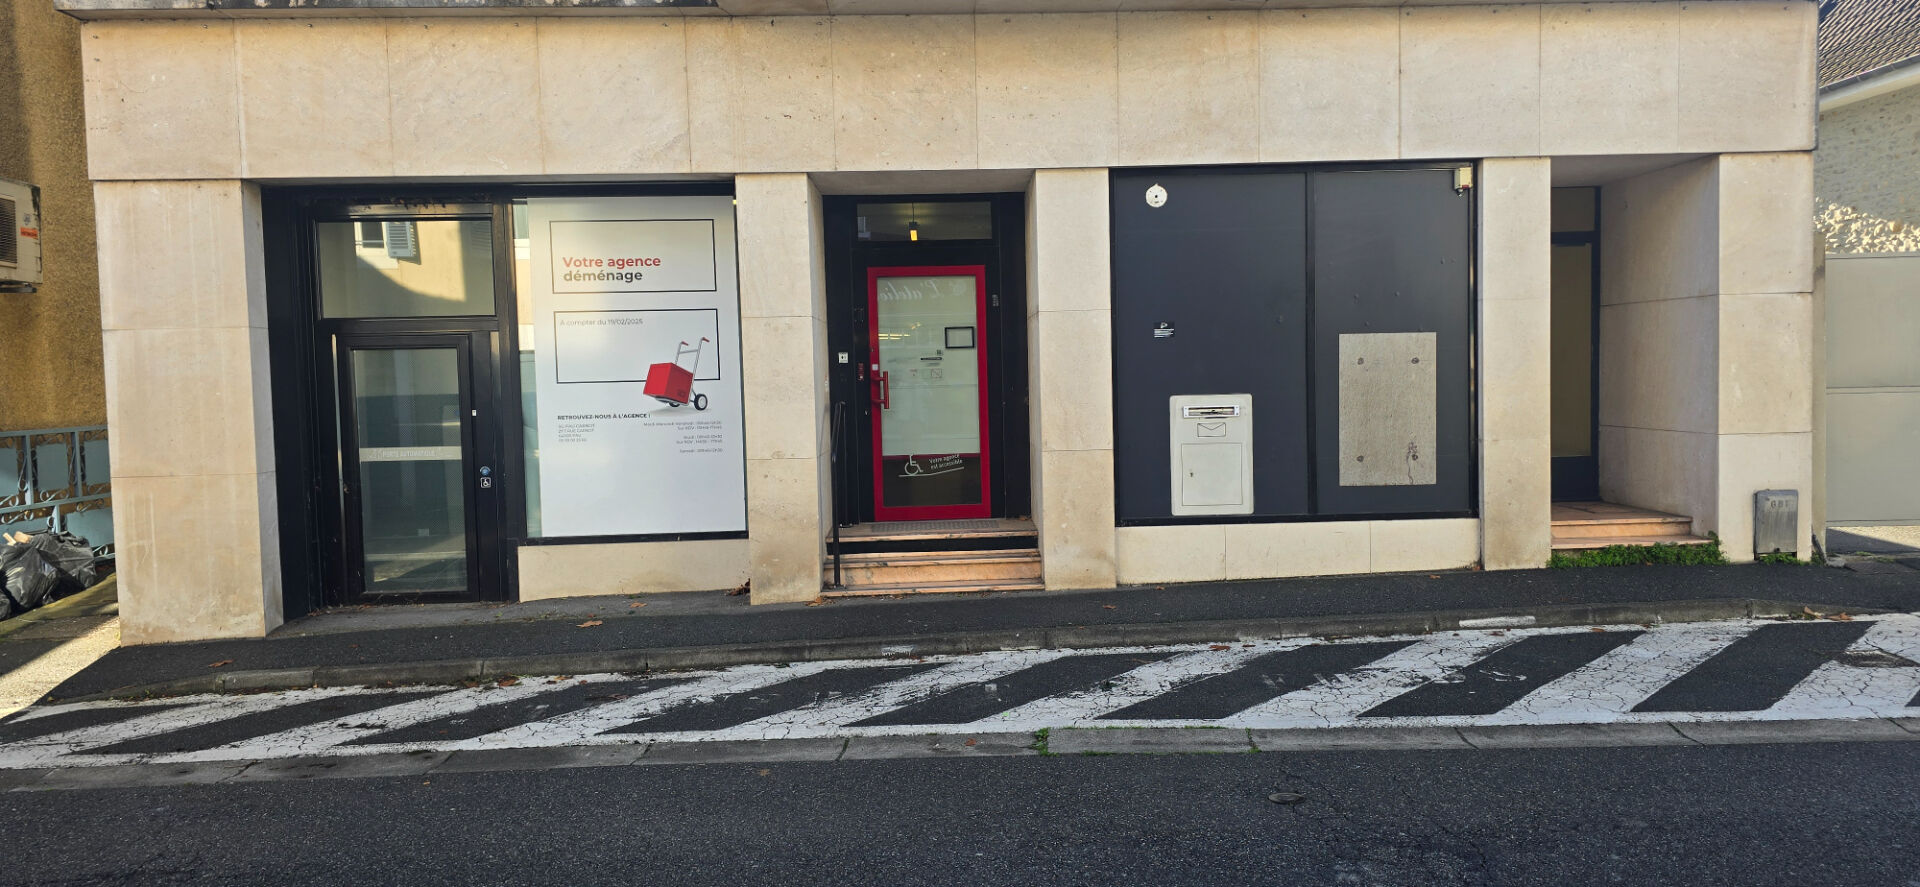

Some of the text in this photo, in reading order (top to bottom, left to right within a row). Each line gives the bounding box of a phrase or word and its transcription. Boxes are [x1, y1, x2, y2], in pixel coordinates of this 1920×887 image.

[562, 256, 661, 270] Votre agence
[563, 270, 643, 283] déménage
[597, 318, 607, 326] du
